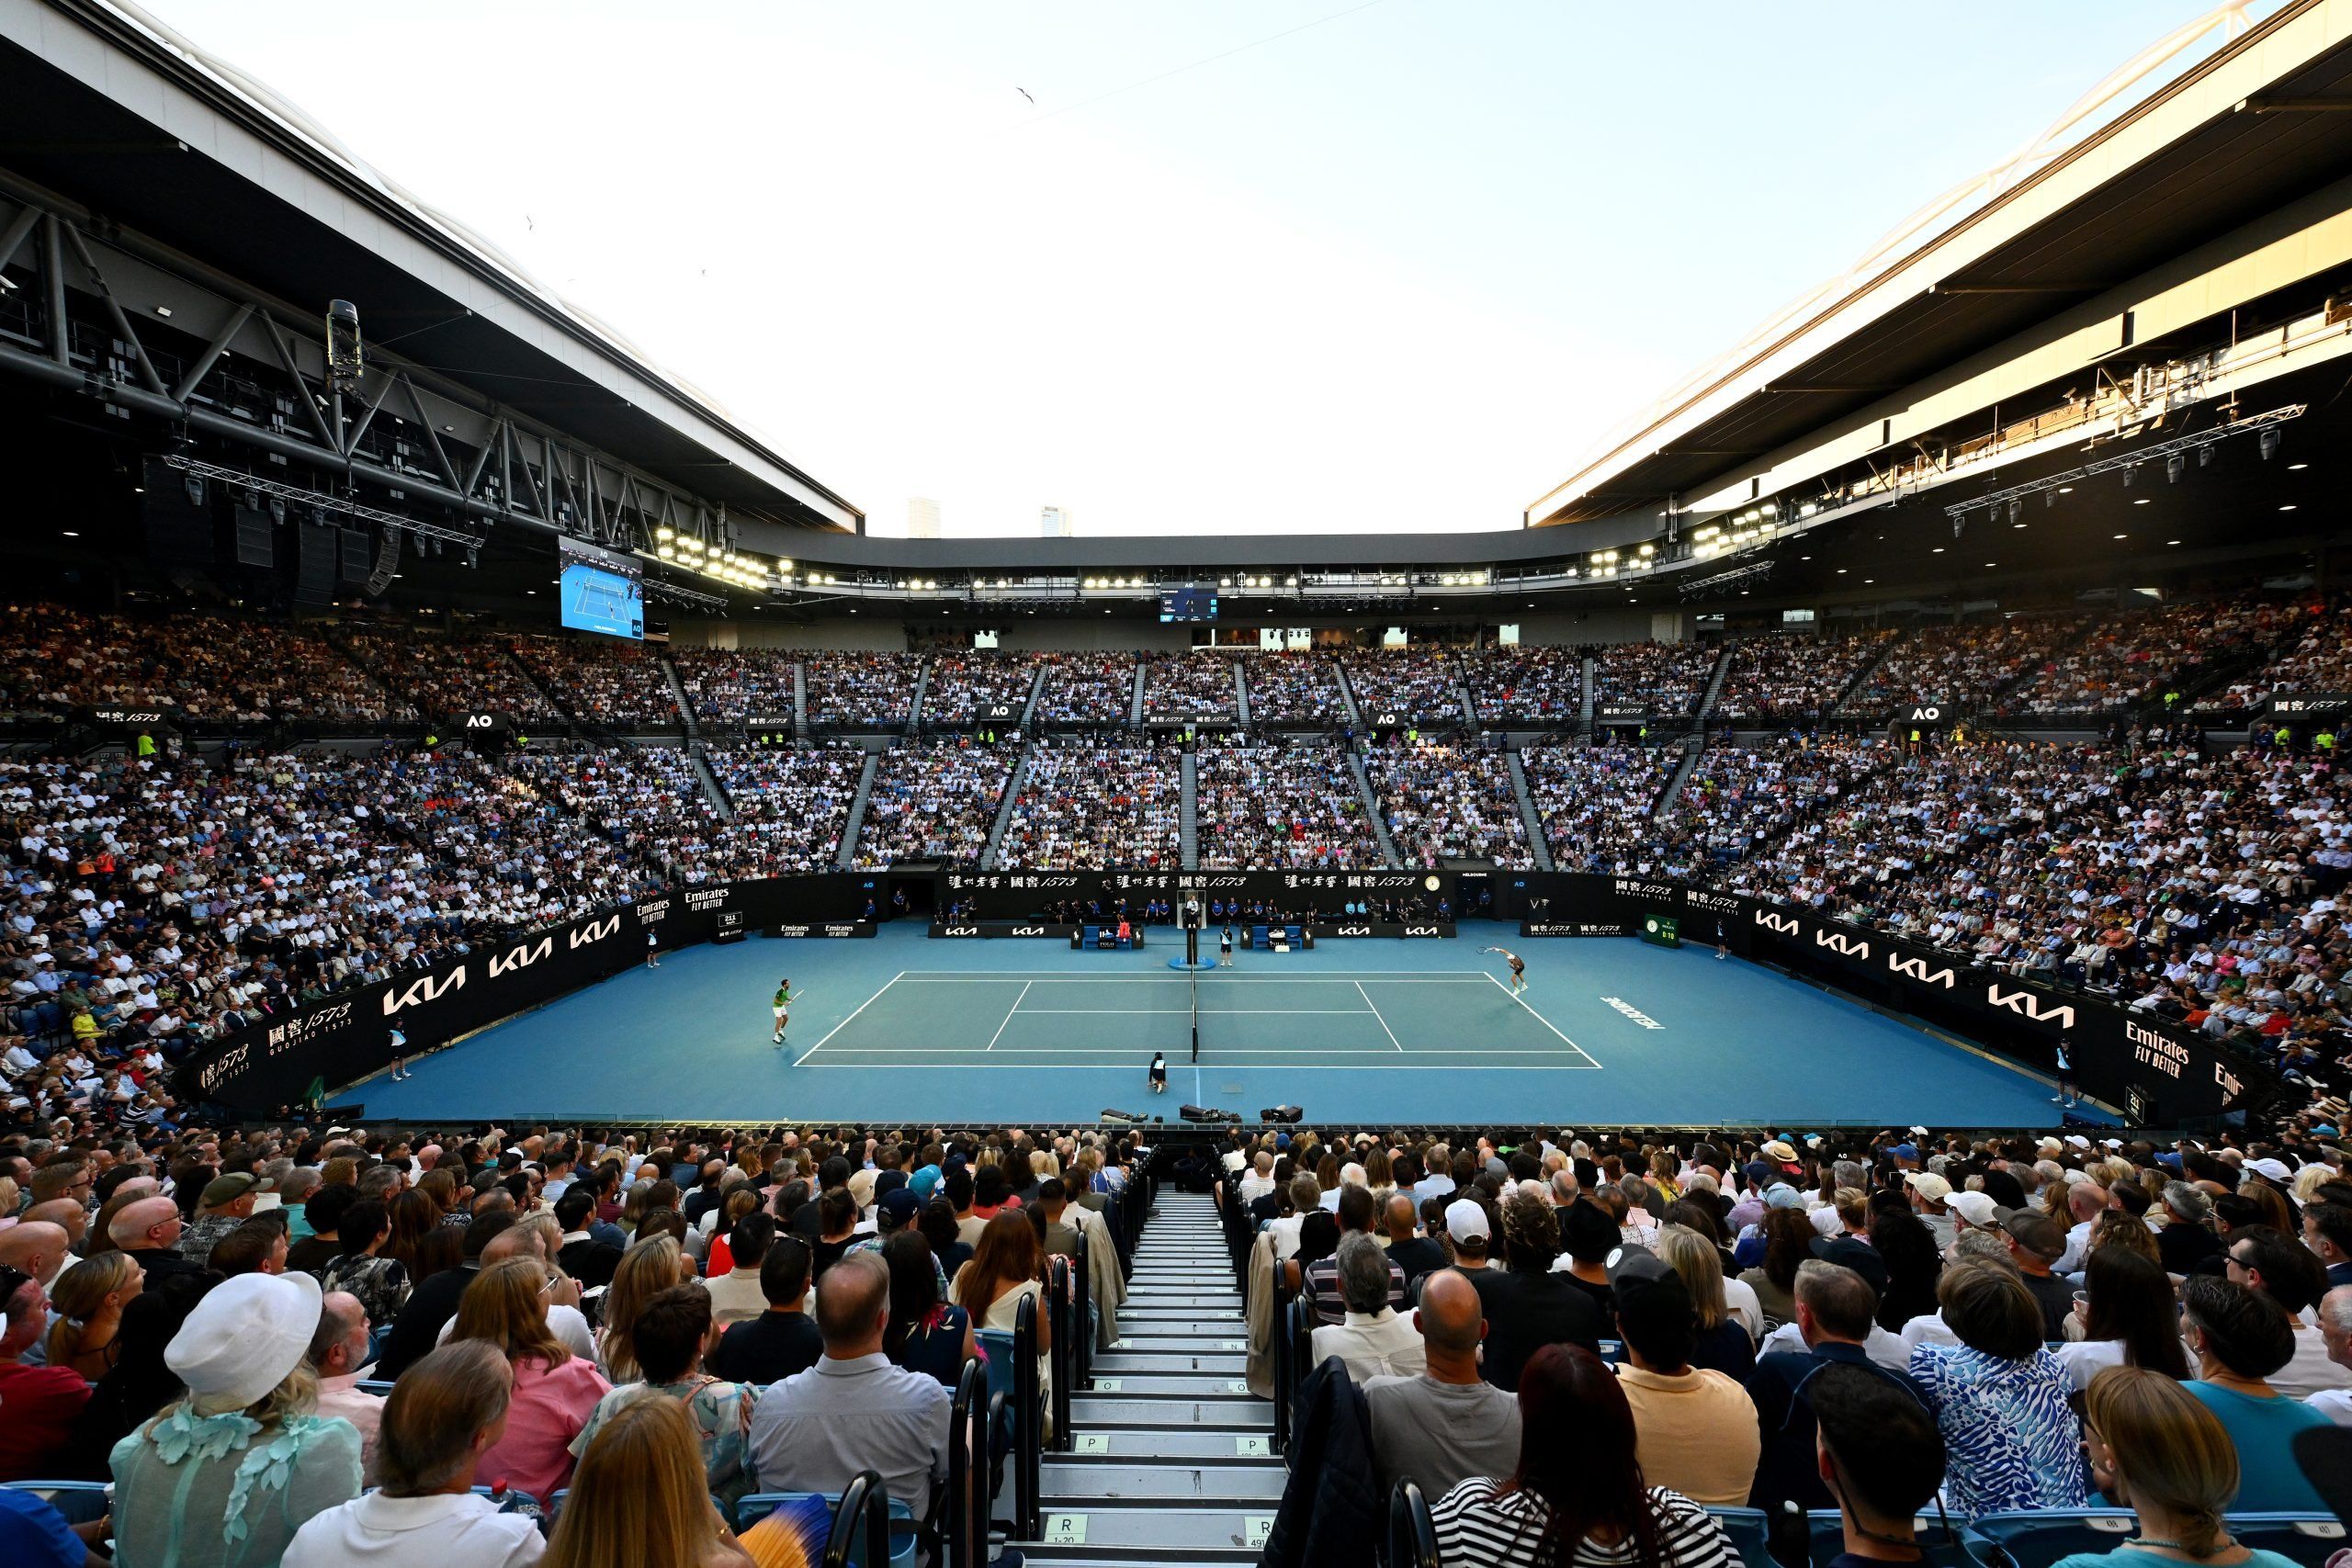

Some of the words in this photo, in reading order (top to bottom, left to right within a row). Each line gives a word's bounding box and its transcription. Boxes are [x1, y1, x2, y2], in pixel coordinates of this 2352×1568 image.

[990, 706, 1009, 716] AO
[1911, 707, 1939, 720] AO
[466, 715, 492, 728] AO
[1377, 715, 1396, 724] AO
[684, 887, 729, 903] Emirates
[637, 899, 670, 917] Emirates
[691, 902, 701, 911] FLY
[703, 898, 723, 909] BETTER
[1756, 908, 1799, 936] KIA
[570, 914, 619, 949] KIA
[945, 927, 978, 935] KIA
[1012, 927, 1044, 935] KIA
[1338, 926, 1370, 935] KIA
[1406, 926, 1438, 935] KIA
[1816, 929, 1869, 960] KIA
[489, 936, 552, 978] KIA
[1889, 952, 1954, 989] KIA
[383, 964, 466, 1016] KIA
[1988, 983, 2075, 1029] KIA
[269, 1031, 316, 1055] GUOJIAO
[325, 1018, 352, 1033] 1573
[2126, 1020, 2189, 1065] Emirates
[2135, 1045, 2152, 1064] FLY
[2152, 1054, 2180, 1079] BETTER
[2130, 1093, 2140, 1111] 211
[1238, 1383, 1246, 1392] O
[1088, 1438, 1096, 1448] P
[1249, 1440, 1256, 1450] P
[1061, 1518, 1071, 1531] R
[1261, 1521, 1271, 1534] R
